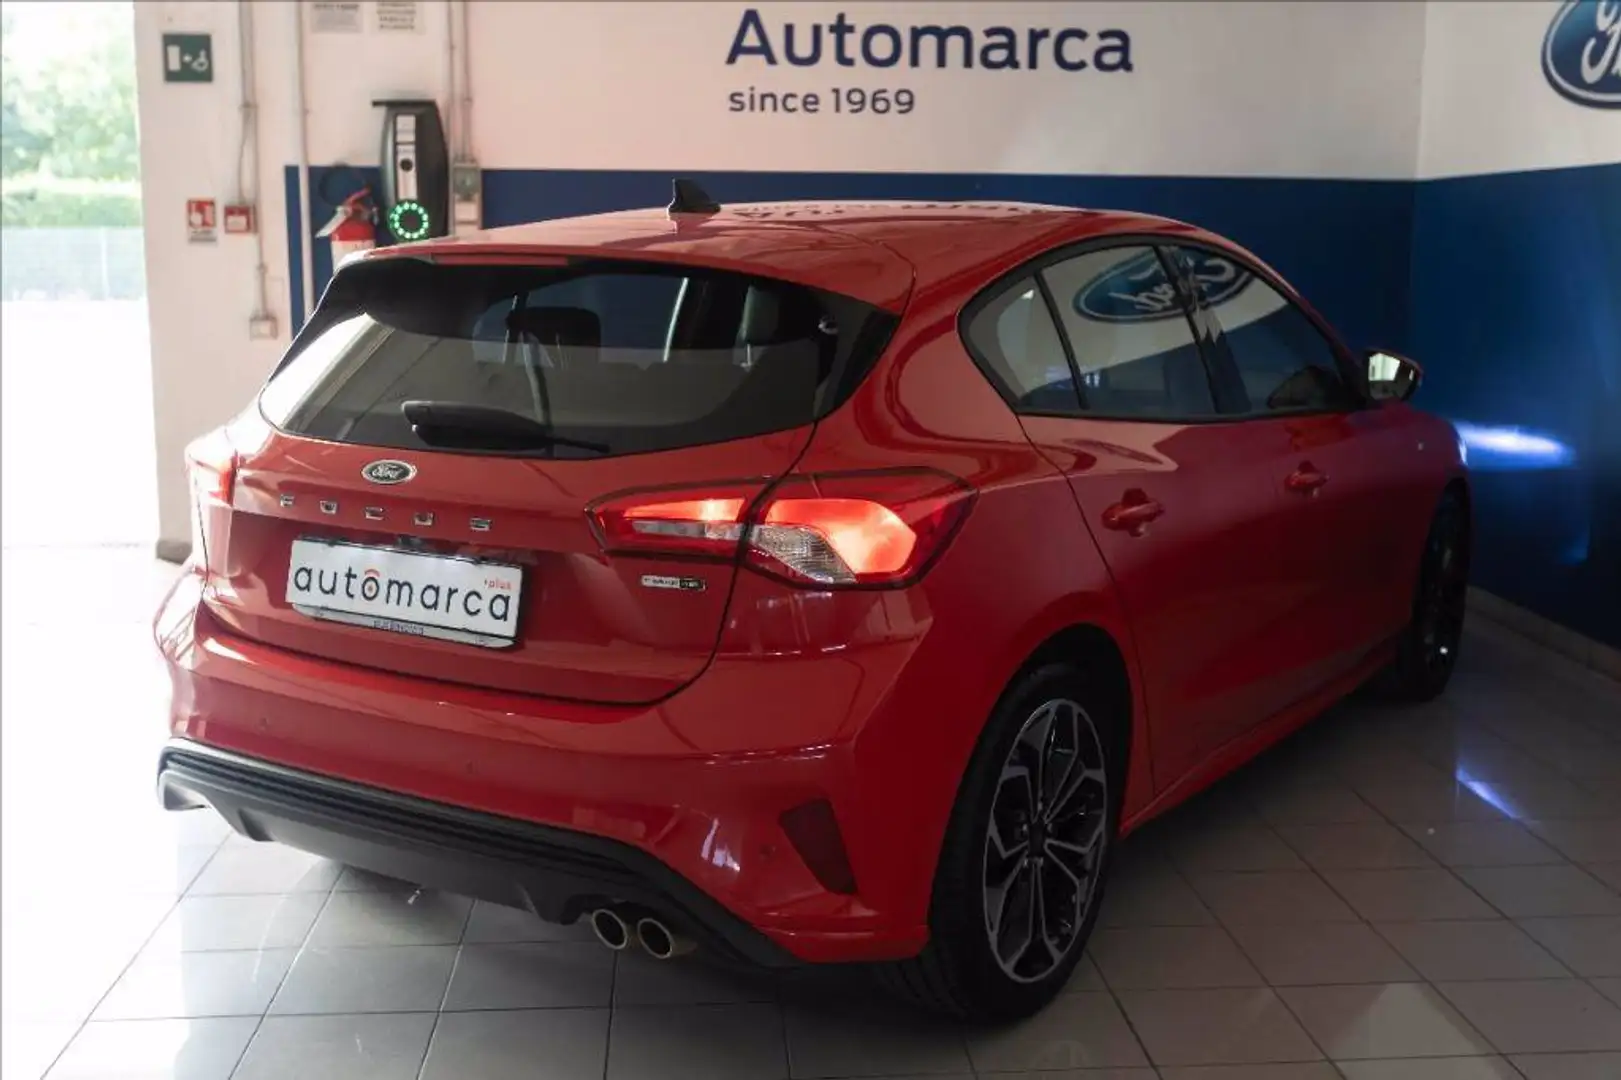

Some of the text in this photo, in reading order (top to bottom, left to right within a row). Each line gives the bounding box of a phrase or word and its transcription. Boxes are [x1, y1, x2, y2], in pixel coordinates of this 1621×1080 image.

[725, 8, 1133, 73] Automarca
[728, 86, 916, 115] since 1969
[279, 494, 494, 532] FOCUS
[293, 565, 512, 622] automarca
